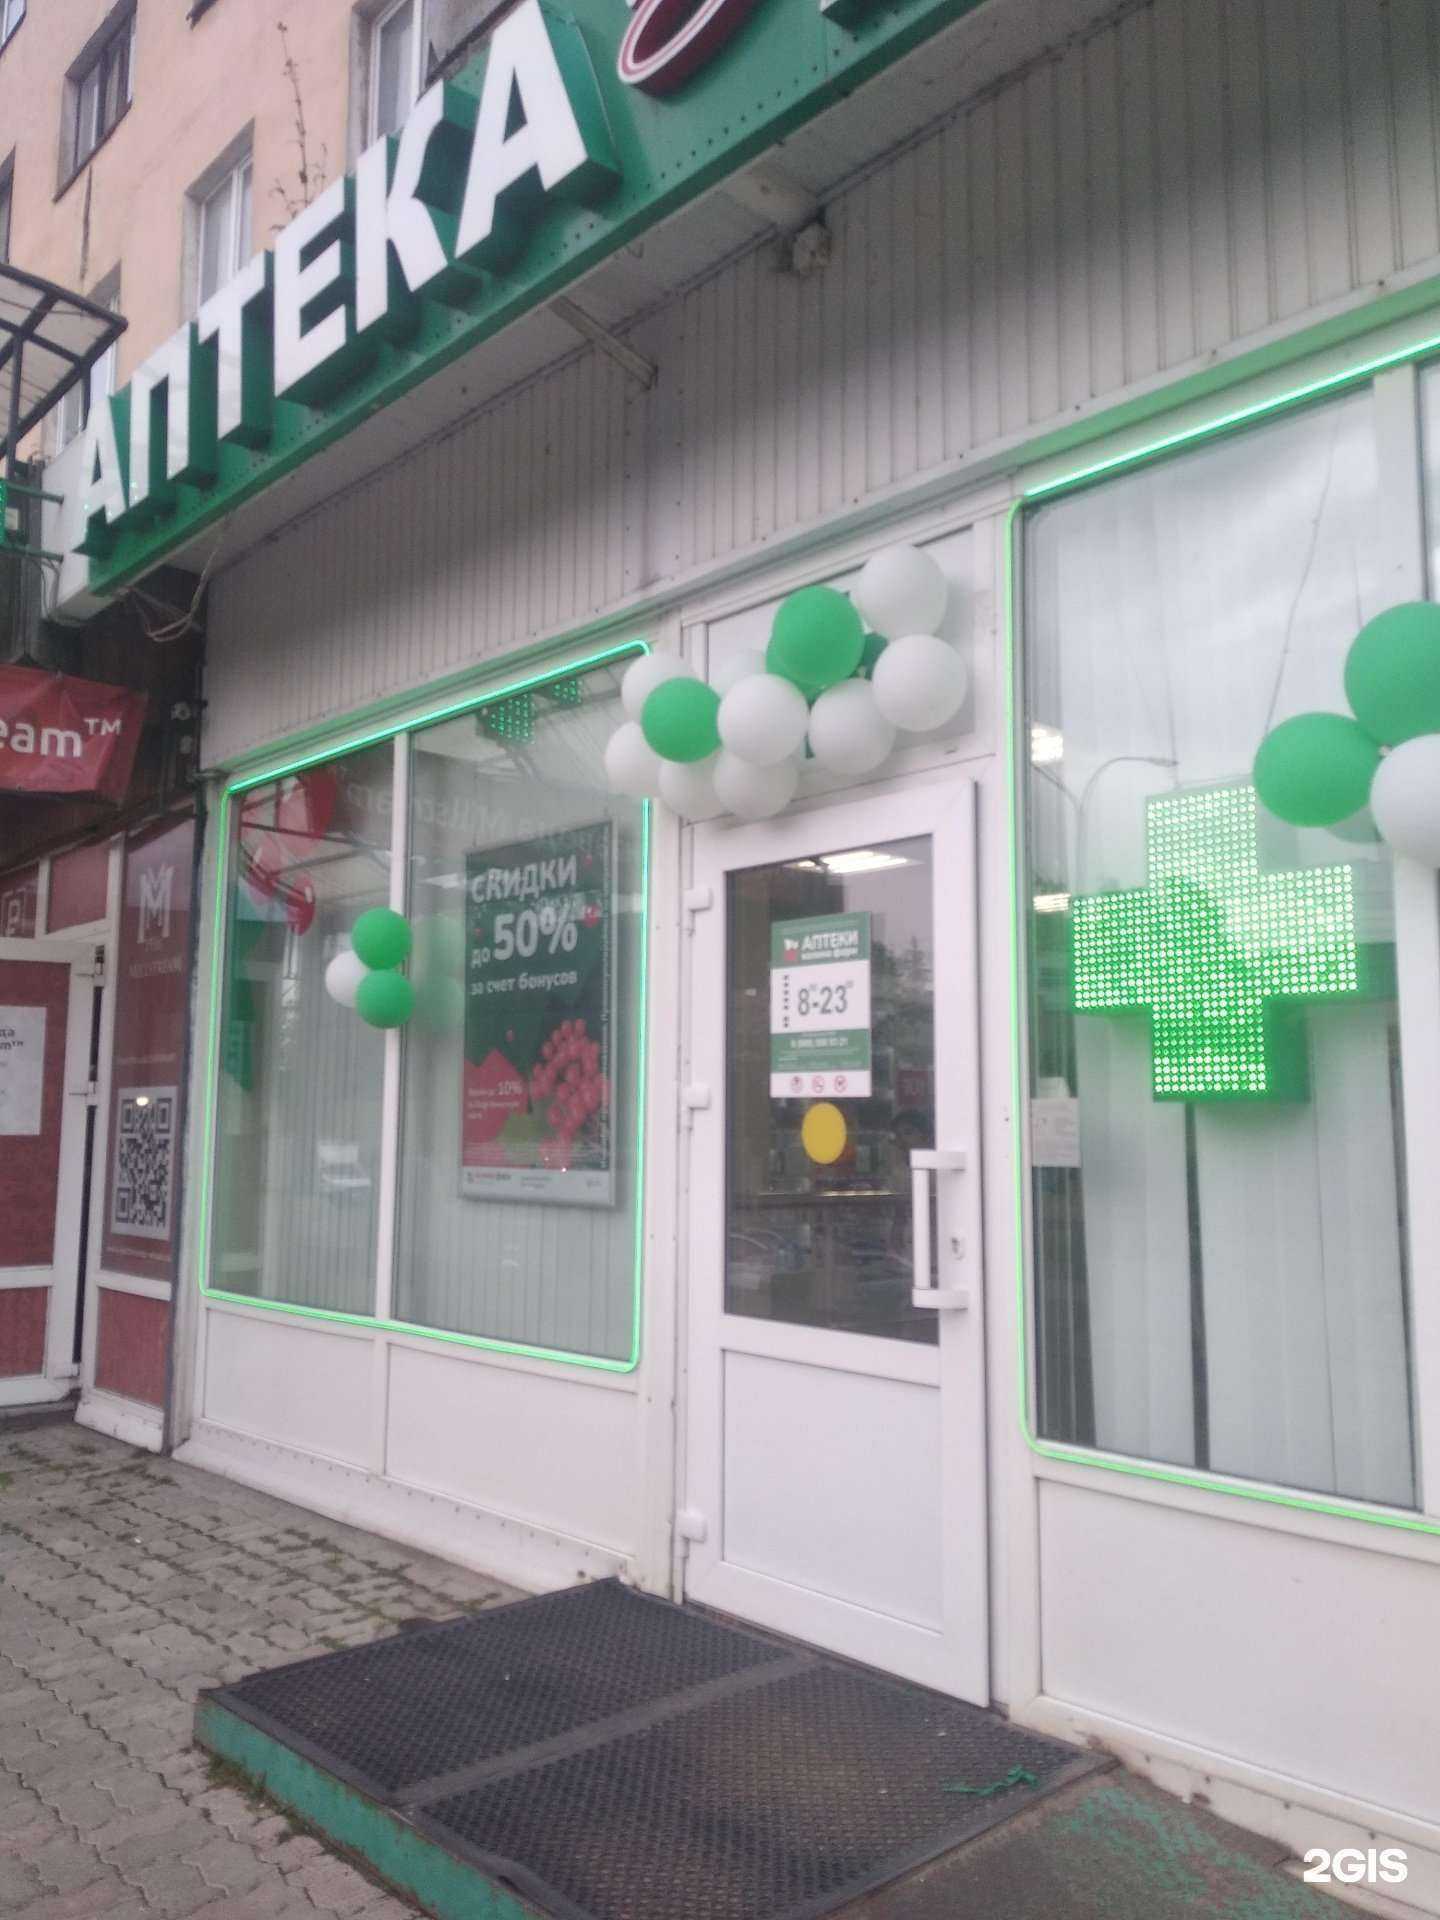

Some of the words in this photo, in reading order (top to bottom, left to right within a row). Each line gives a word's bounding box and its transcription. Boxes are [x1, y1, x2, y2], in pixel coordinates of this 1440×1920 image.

[73, 0, 588, 550] АПТЕКА
[471, 854, 577, 903] СКИДКИ
[471, 947, 491, 968] до
[493, 906, 578, 960] 50%
[487, 978, 516, 993] счет
[518, 971, 578, 991] бонусов
